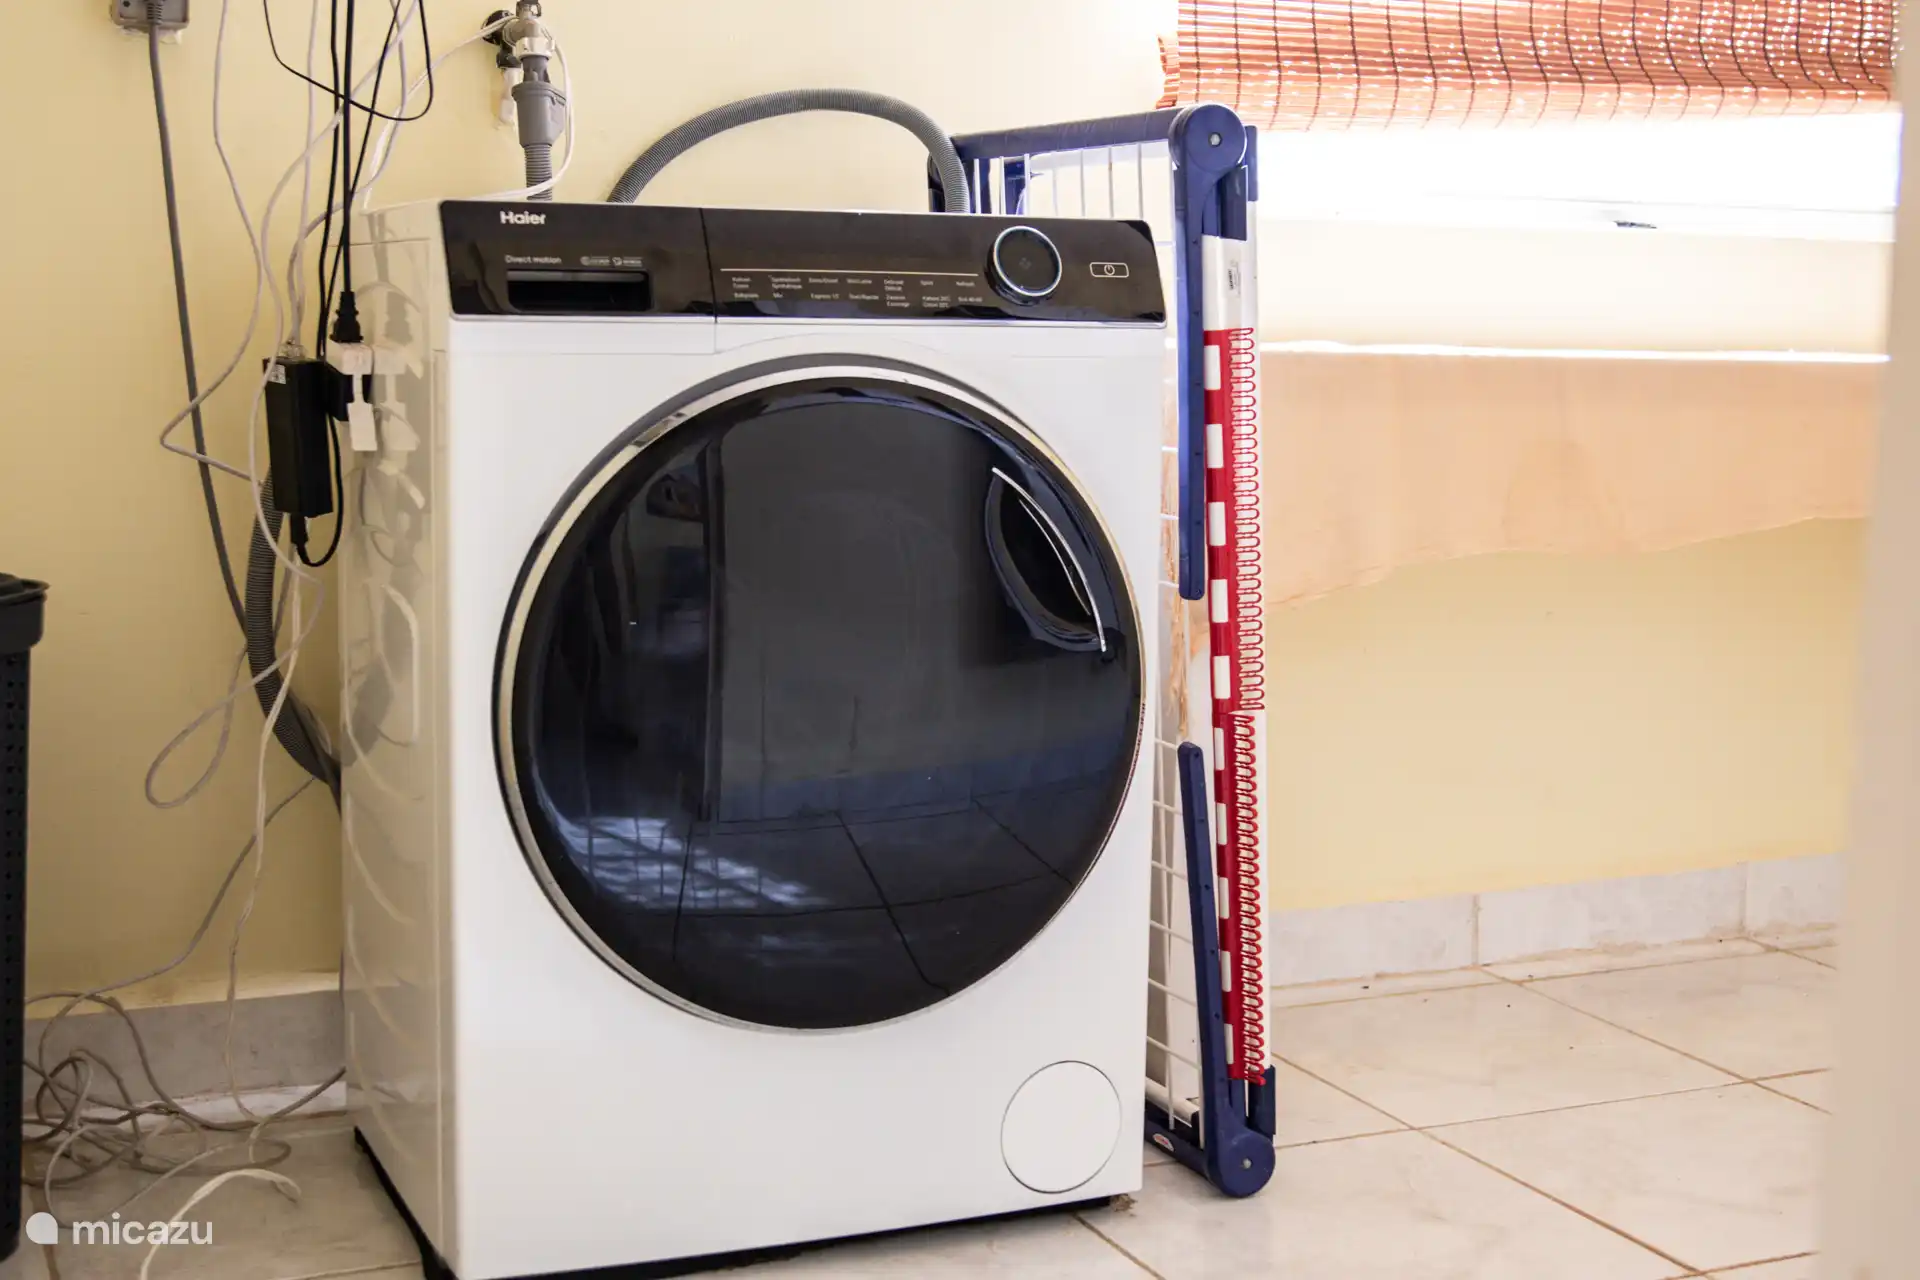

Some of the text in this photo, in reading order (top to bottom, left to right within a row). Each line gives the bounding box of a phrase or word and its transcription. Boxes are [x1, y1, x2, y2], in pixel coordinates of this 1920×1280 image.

[500, 210, 546, 225] Haier
[505, 254, 562, 264] Direct motion
